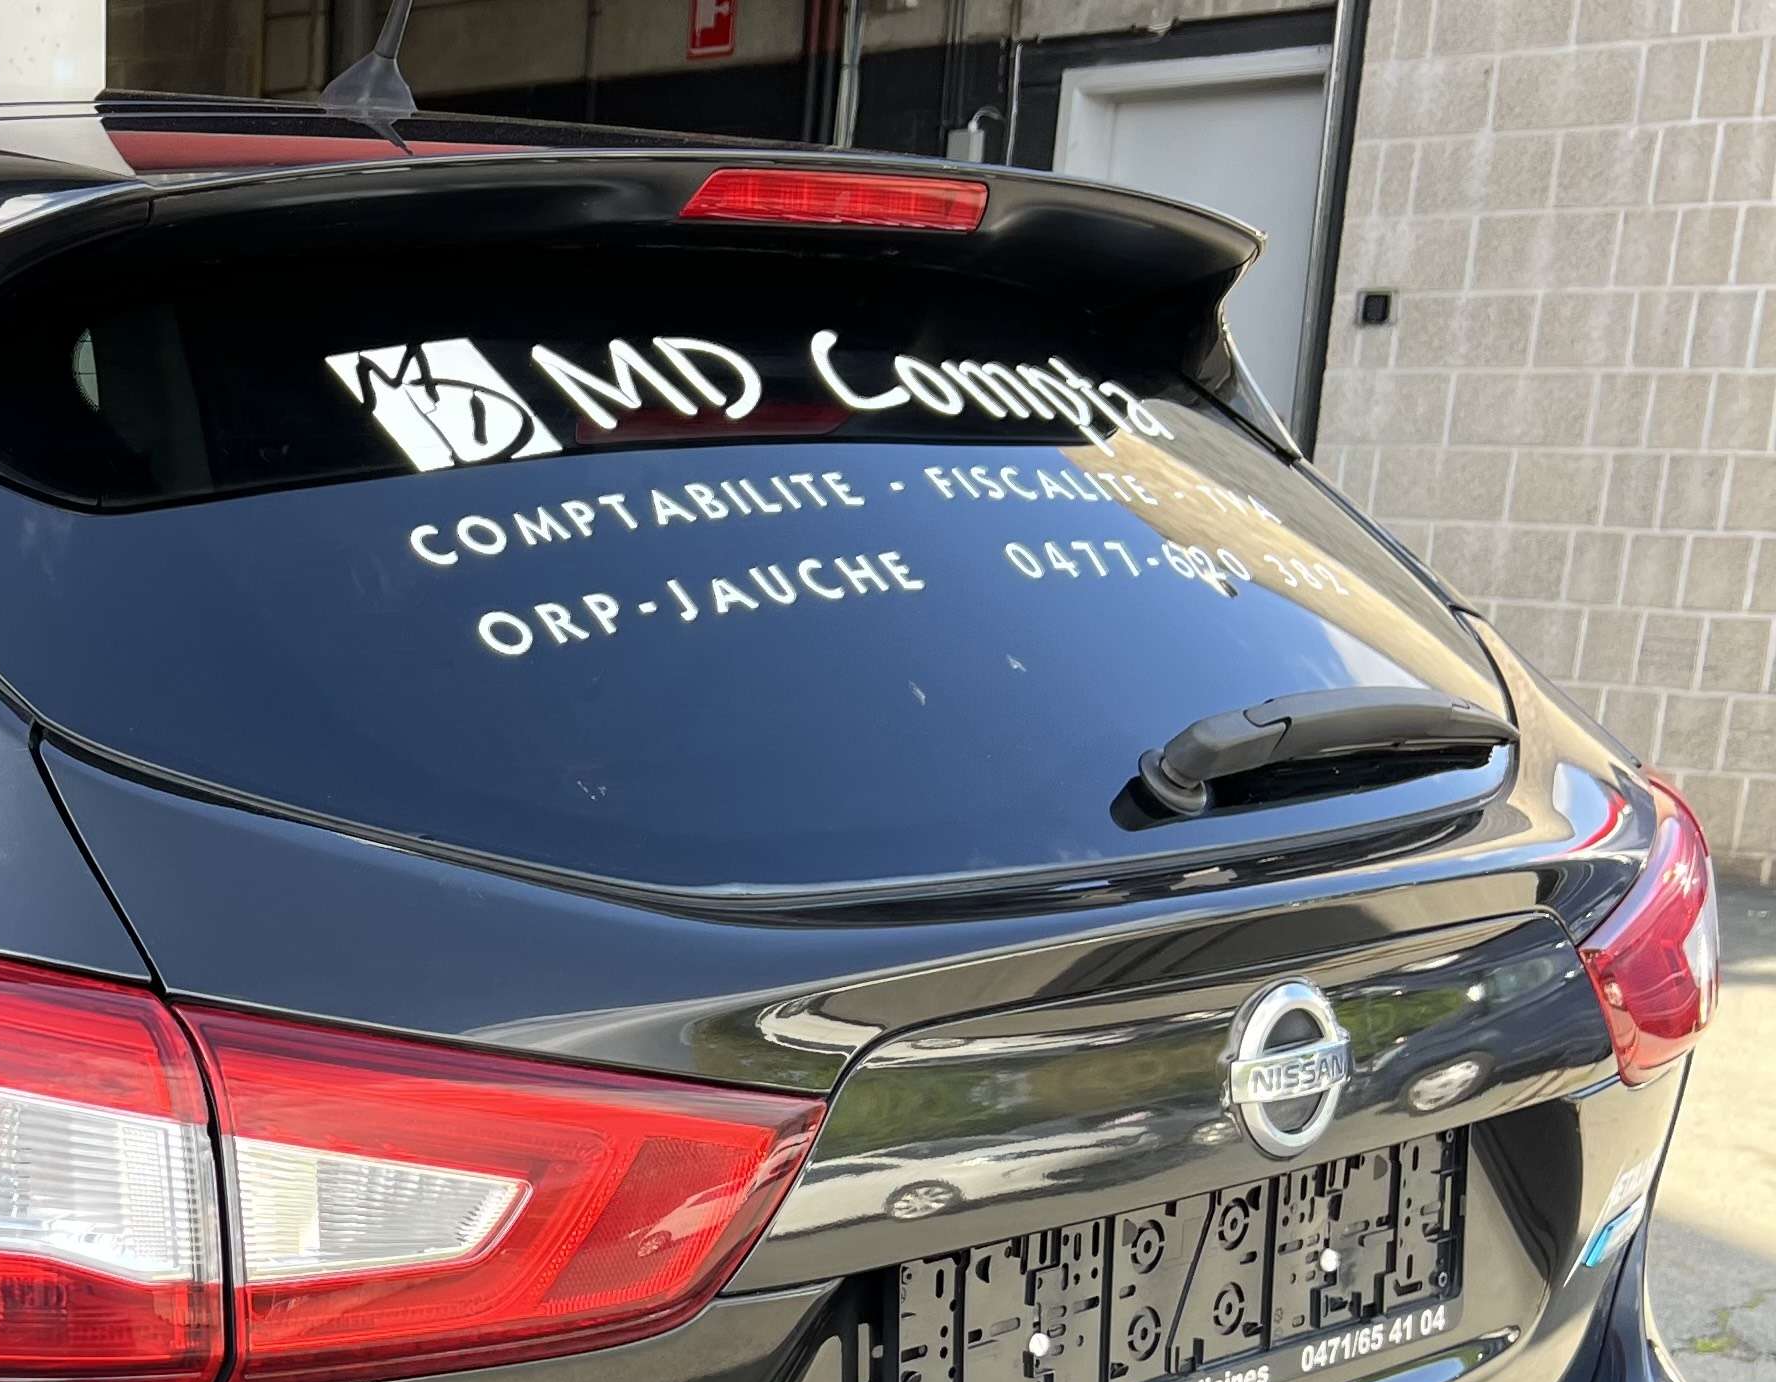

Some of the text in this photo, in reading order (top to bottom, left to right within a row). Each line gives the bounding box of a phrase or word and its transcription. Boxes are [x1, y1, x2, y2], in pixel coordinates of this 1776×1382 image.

[531, 330, 1175, 457] MD Compta
[409, 471, 866, 566] COMPTABILITE
[924, 465, 1158, 506] FISCALITE
[477, 550, 926, 656] ORP-JAUCHE
[1251, 1054, 1346, 1095] NISSAN
[1301, 1322, 1384, 1373] 0471/65
[1388, 1313, 1414, 1345] 41
[1420, 1304, 1446, 1336] 04
